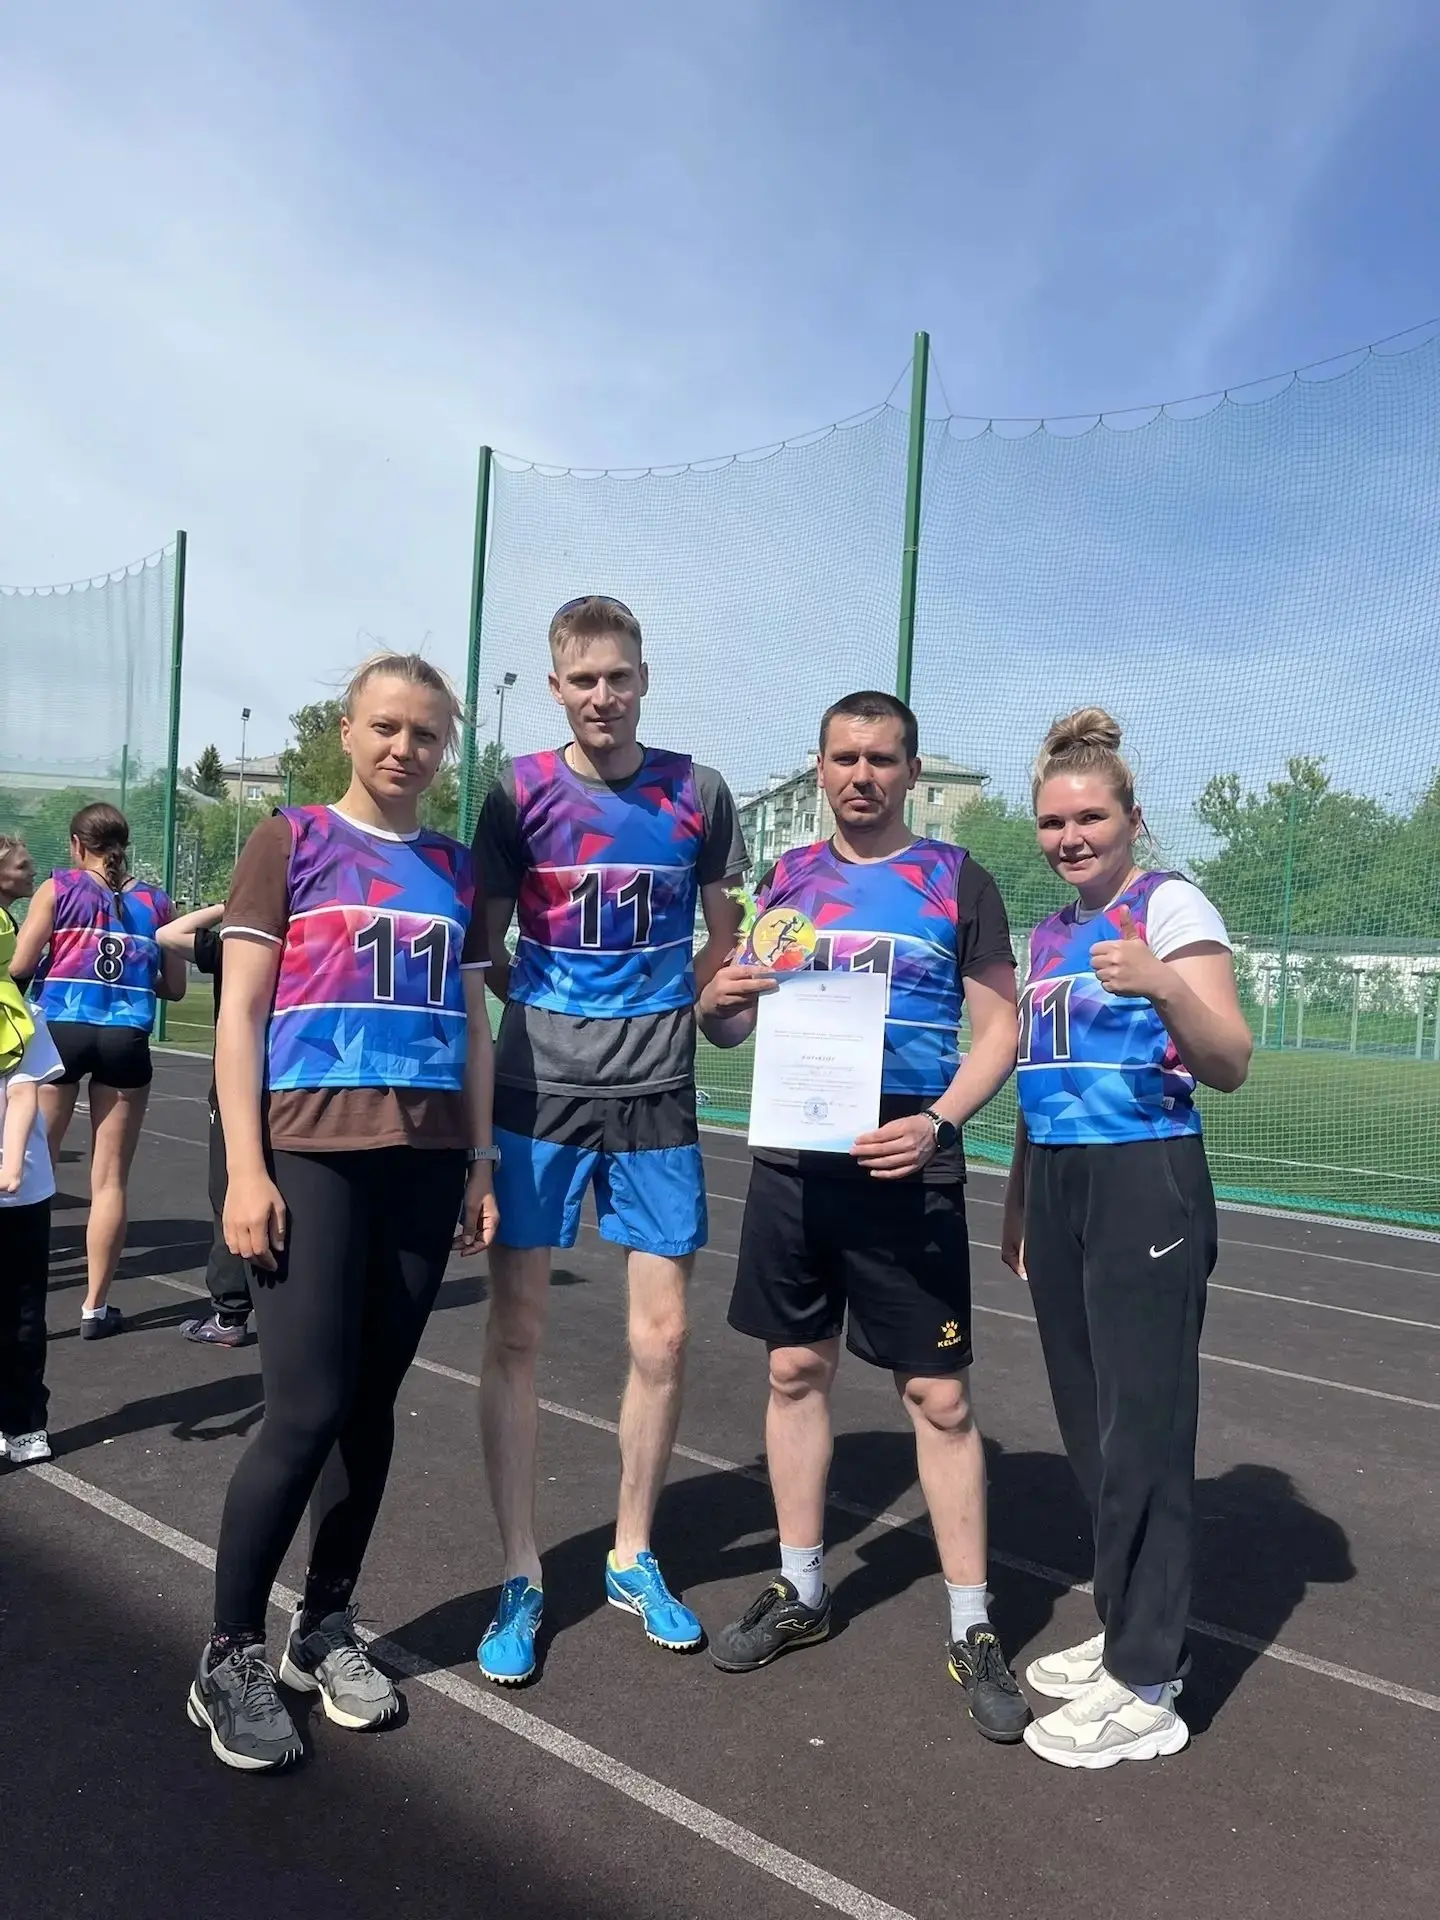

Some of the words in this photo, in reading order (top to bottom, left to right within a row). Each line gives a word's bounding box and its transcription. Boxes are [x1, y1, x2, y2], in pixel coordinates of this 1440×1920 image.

[568, 870, 653, 947] 11
[94, 935, 125, 983] 8
[354, 914, 449, 1006] 11
[1017, 977, 1076, 1063] 11
